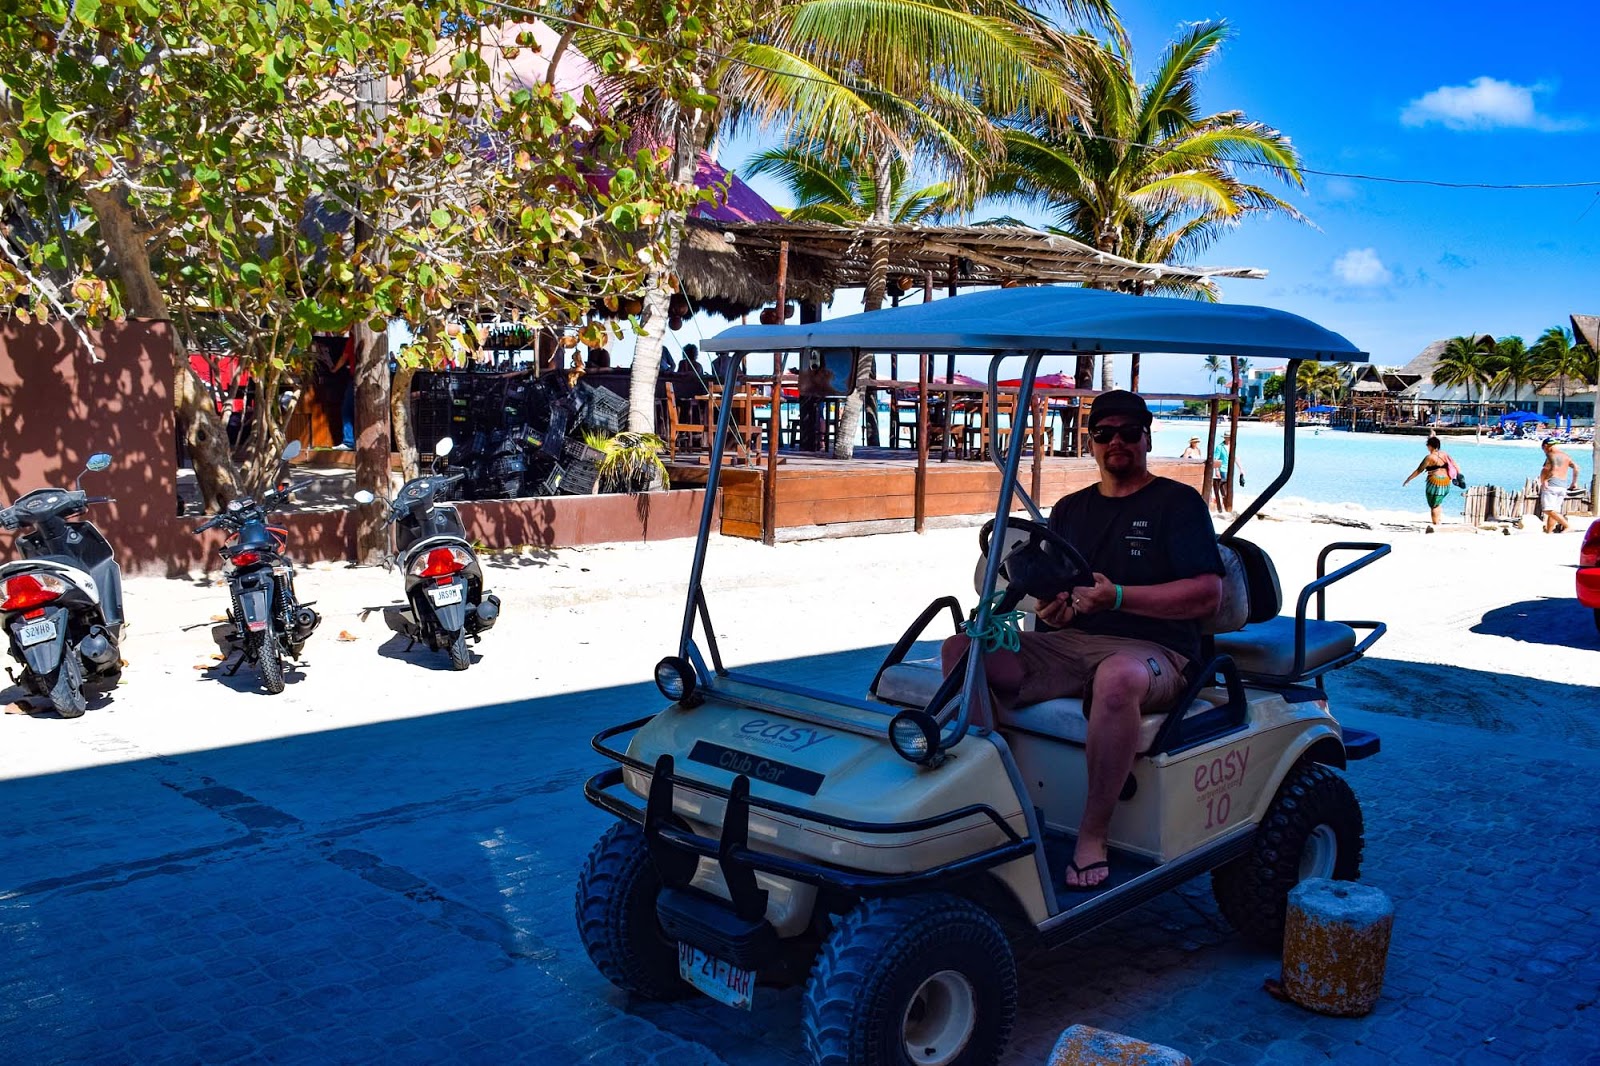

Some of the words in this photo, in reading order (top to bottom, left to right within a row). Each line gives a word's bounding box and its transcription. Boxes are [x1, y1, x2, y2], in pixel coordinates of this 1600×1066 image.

[740, 719, 835, 752] easy
[719, 750, 751, 772] Club
[755, 760, 785, 781] Car
[1195, 746, 1249, 792] easy
[1205, 793, 1230, 829] 10
